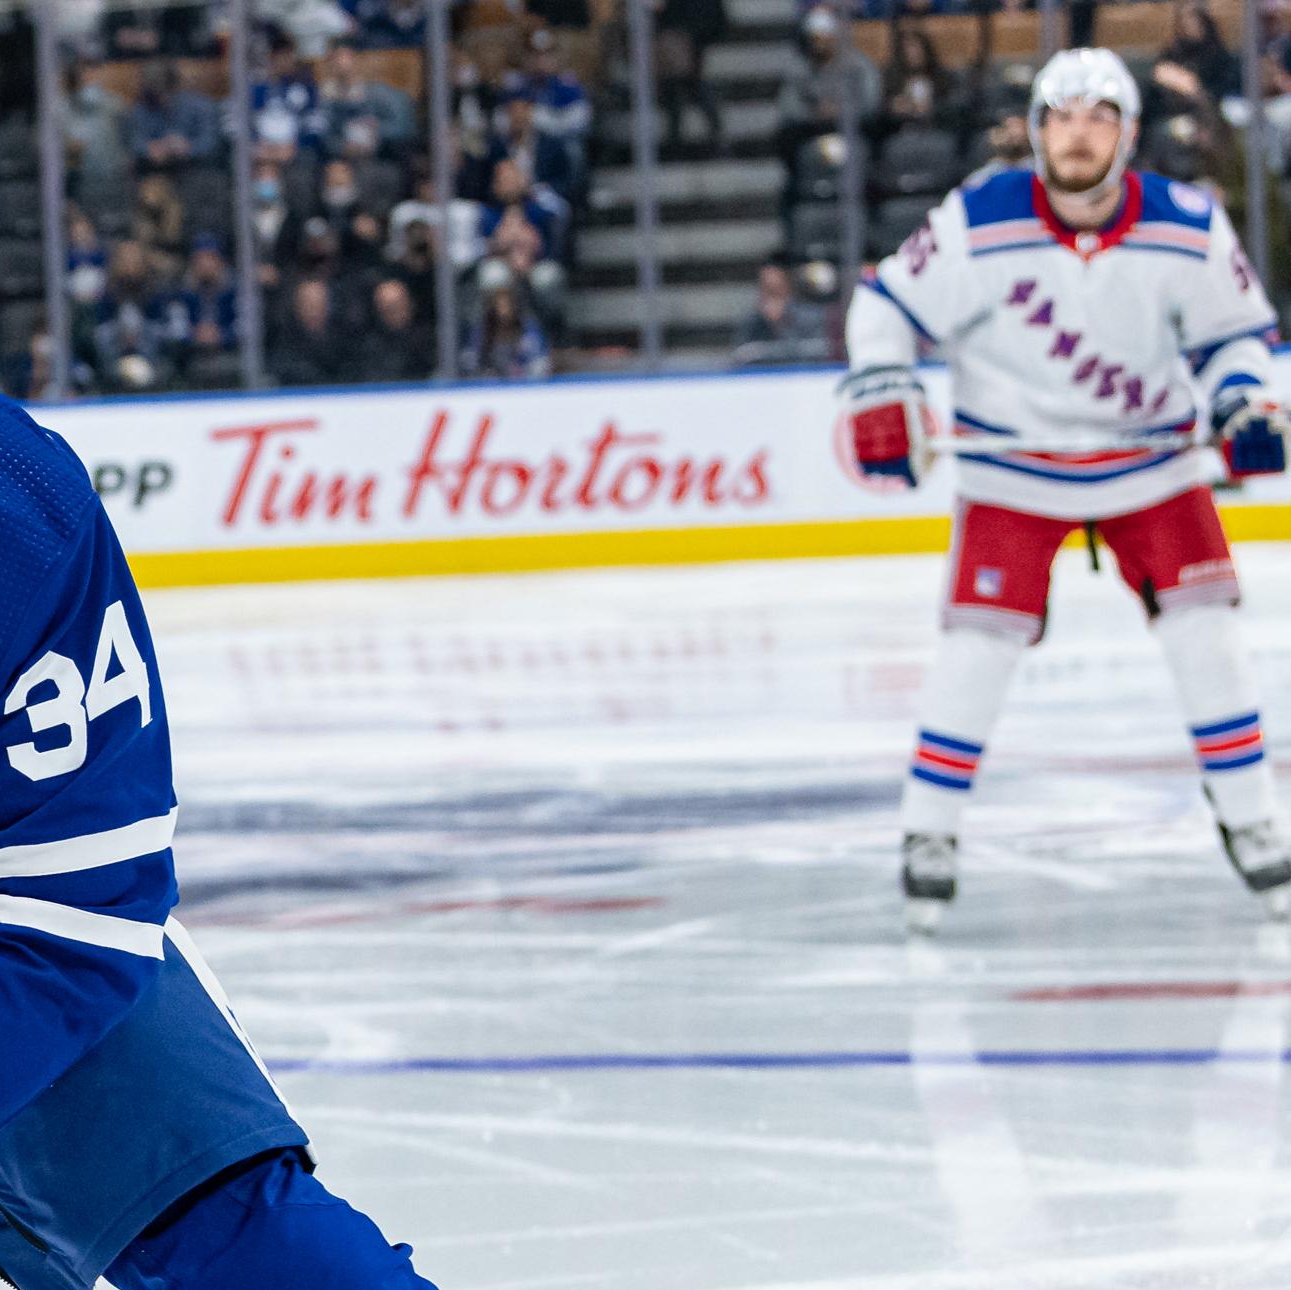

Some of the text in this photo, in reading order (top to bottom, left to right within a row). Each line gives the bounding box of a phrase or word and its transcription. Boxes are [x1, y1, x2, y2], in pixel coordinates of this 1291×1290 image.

[209, 409, 773, 527] Tim Hortons
[4, 600, 153, 782] 34
